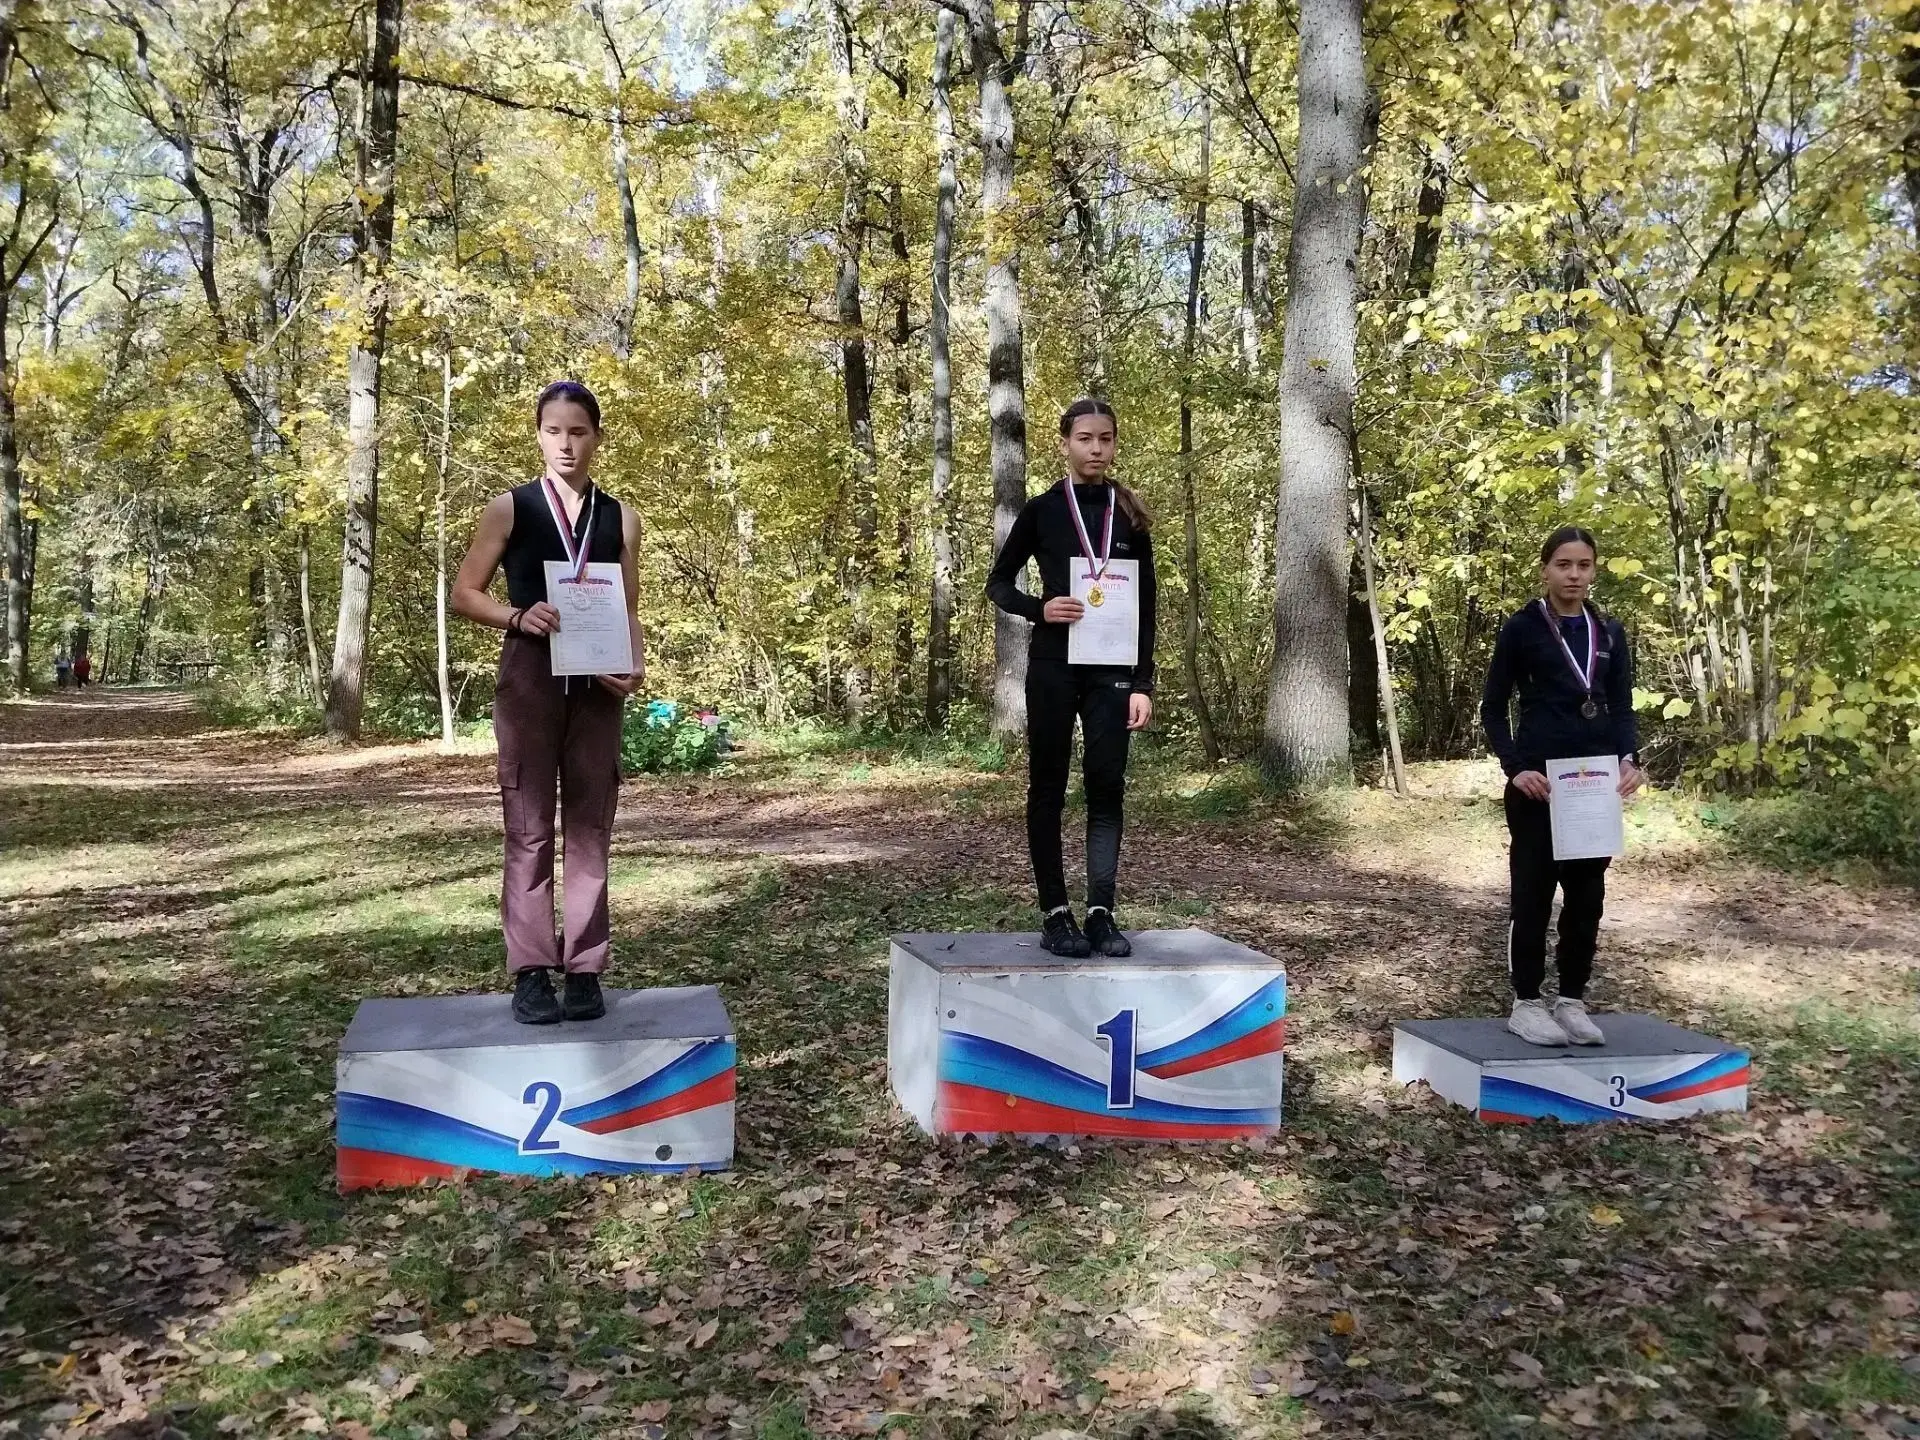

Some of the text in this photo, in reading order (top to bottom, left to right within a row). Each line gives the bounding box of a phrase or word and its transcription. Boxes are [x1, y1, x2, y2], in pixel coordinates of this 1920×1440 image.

[1566, 779, 1602, 790] ГРАМОТА
[1096, 1009, 1135, 1108] 1
[522, 1081, 562, 1152] 2
[1609, 1075, 1626, 1108] 3
